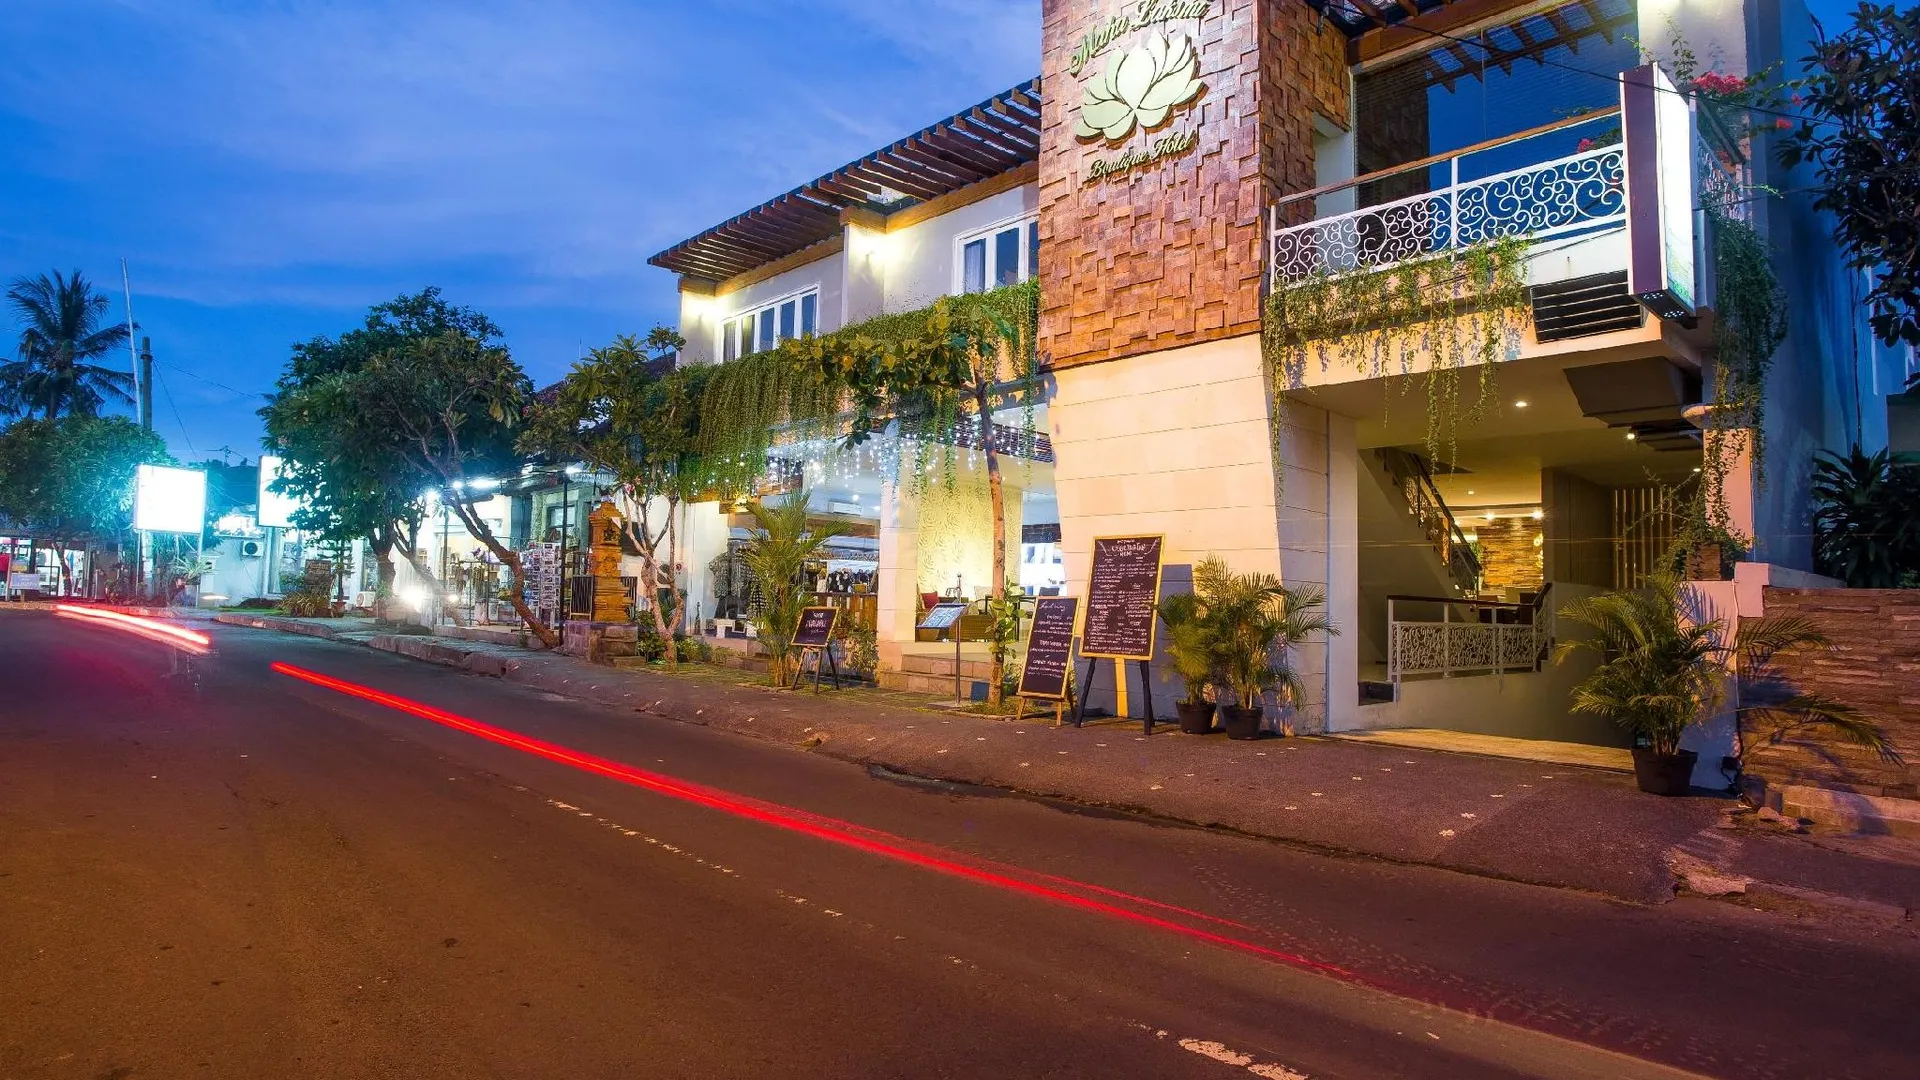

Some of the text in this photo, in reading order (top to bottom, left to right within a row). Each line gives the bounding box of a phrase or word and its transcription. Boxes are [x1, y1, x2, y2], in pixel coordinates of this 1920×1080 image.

[1069, 15, 1130, 77] Maha
[1086, 130, 1196, 179] Boutique Hotel
